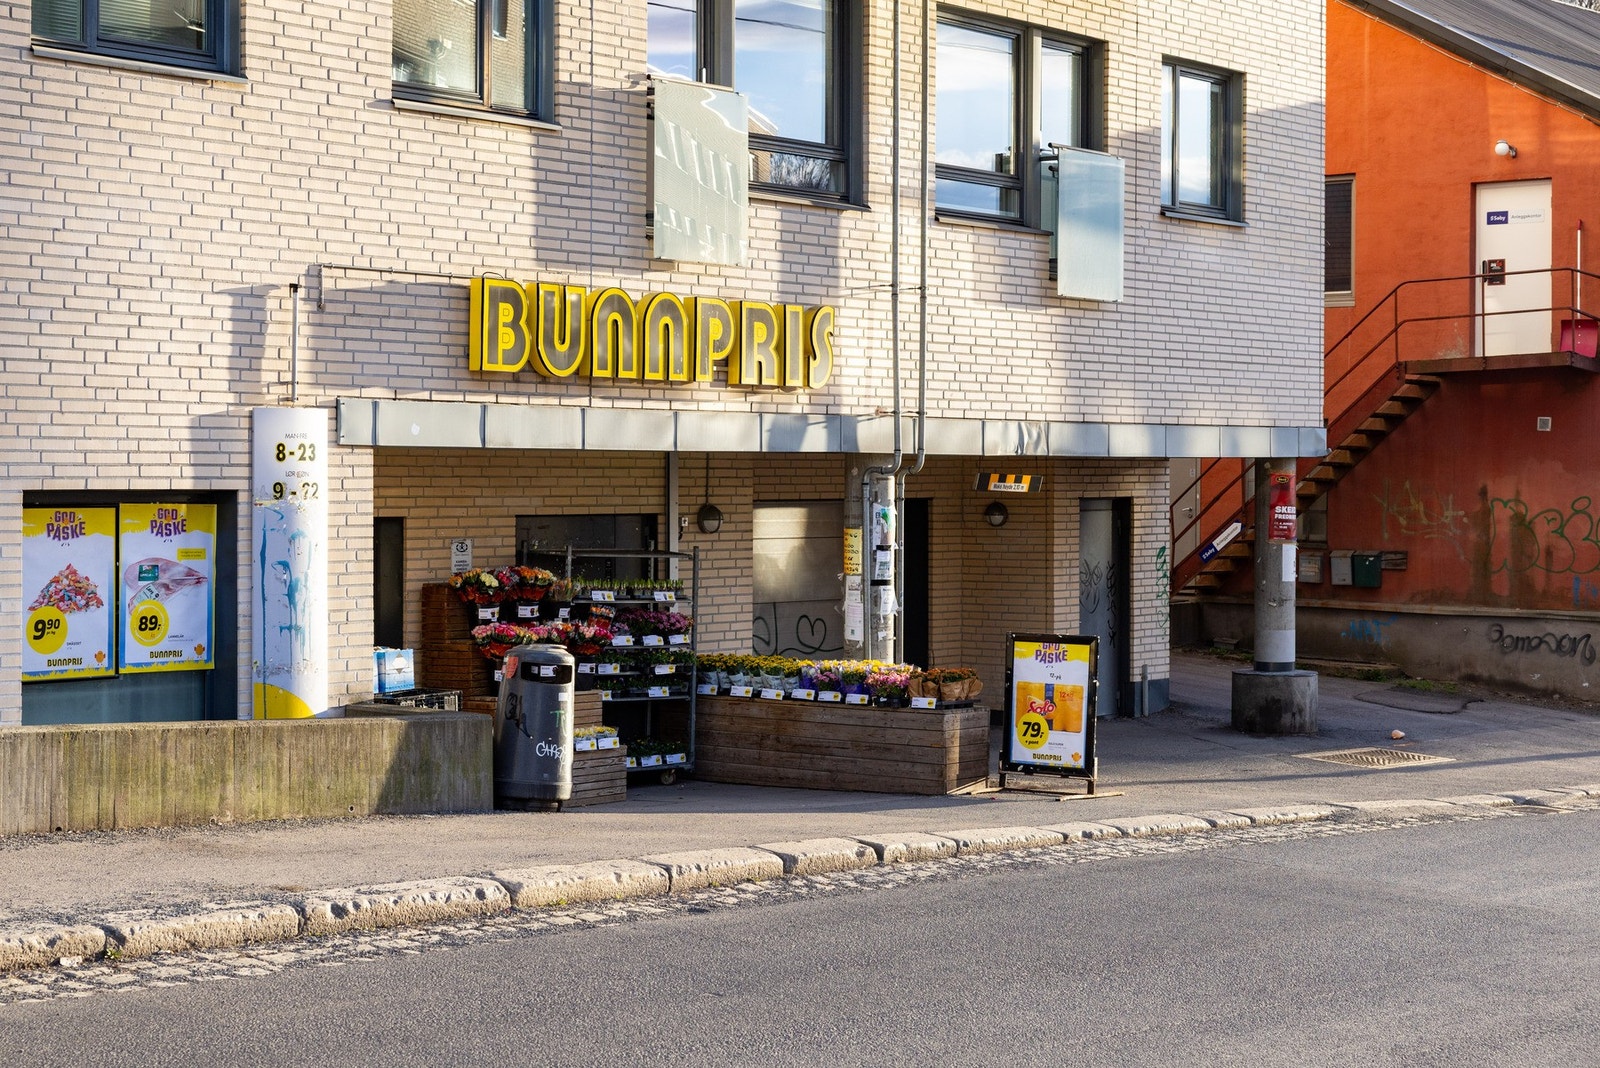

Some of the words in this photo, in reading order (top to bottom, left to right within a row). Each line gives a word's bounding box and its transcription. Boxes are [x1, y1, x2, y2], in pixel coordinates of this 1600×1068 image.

[469, 277, 835, 389] BUNNPRIS
[54, 510, 76, 523] GOD
[157, 507, 178, 519] GOD
[46, 521, 86, 541] PÅSKE
[150, 518, 187, 538] PÅSKE
[149, 650, 183, 659] BUNNPRIS
[1035, 649, 1069, 664] PÅSKE
[47, 657, 83, 667] BUNNPRIS
[1032, 753, 1062, 761] BUNNPRIS
